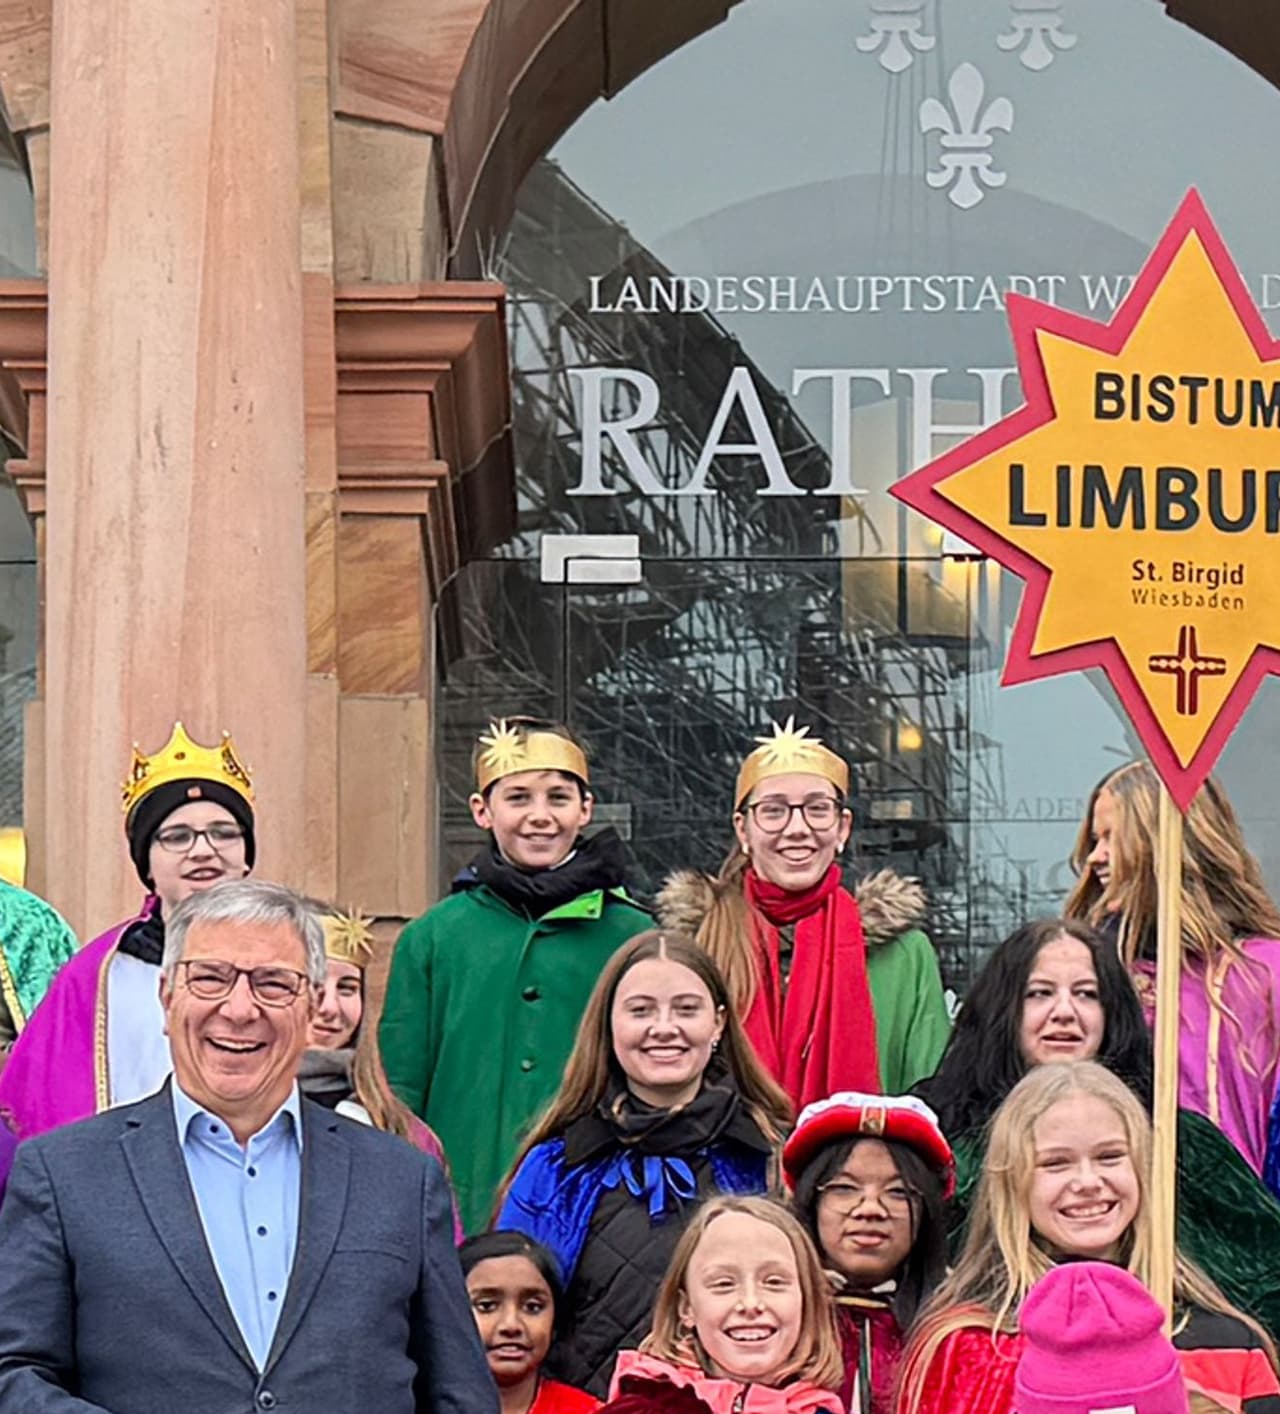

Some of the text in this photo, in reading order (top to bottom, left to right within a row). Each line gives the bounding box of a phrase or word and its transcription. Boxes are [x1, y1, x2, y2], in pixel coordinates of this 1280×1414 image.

[588, 275, 1067, 313] LANDESHAUPTSTADT
[565, 367, 1024, 496] RATH
[1131, 559, 1244, 590] St. Birgid
[1131, 588, 1244, 610] Wiesbaden
